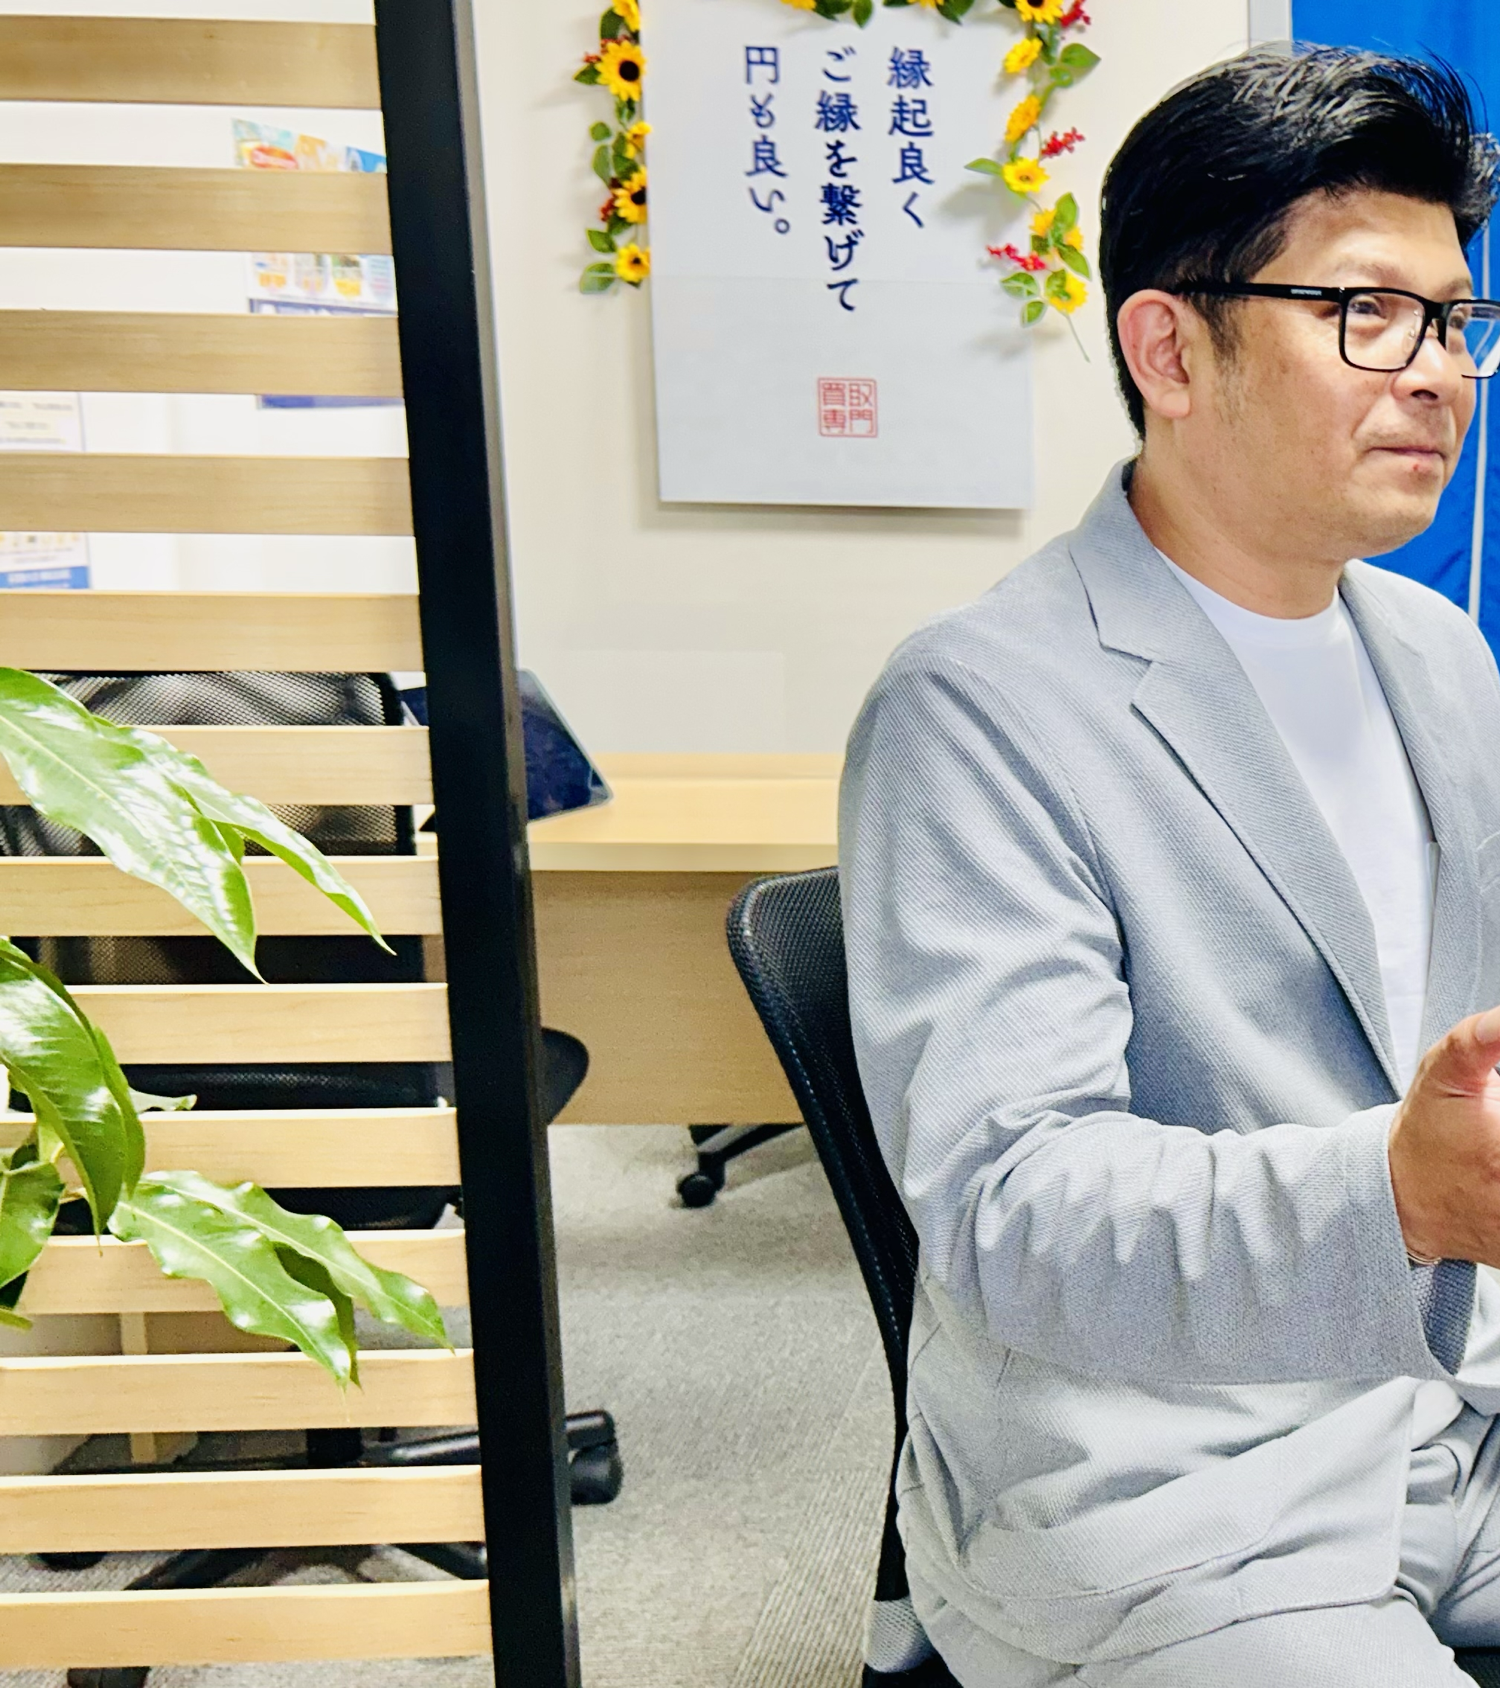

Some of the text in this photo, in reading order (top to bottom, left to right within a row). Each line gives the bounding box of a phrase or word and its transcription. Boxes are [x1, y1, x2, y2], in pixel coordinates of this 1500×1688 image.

[743, 45, 791, 237] 円も良い。
[815, 46, 865, 312] ご縁を繋げて
[886, 45, 935, 229] 縁起良く
